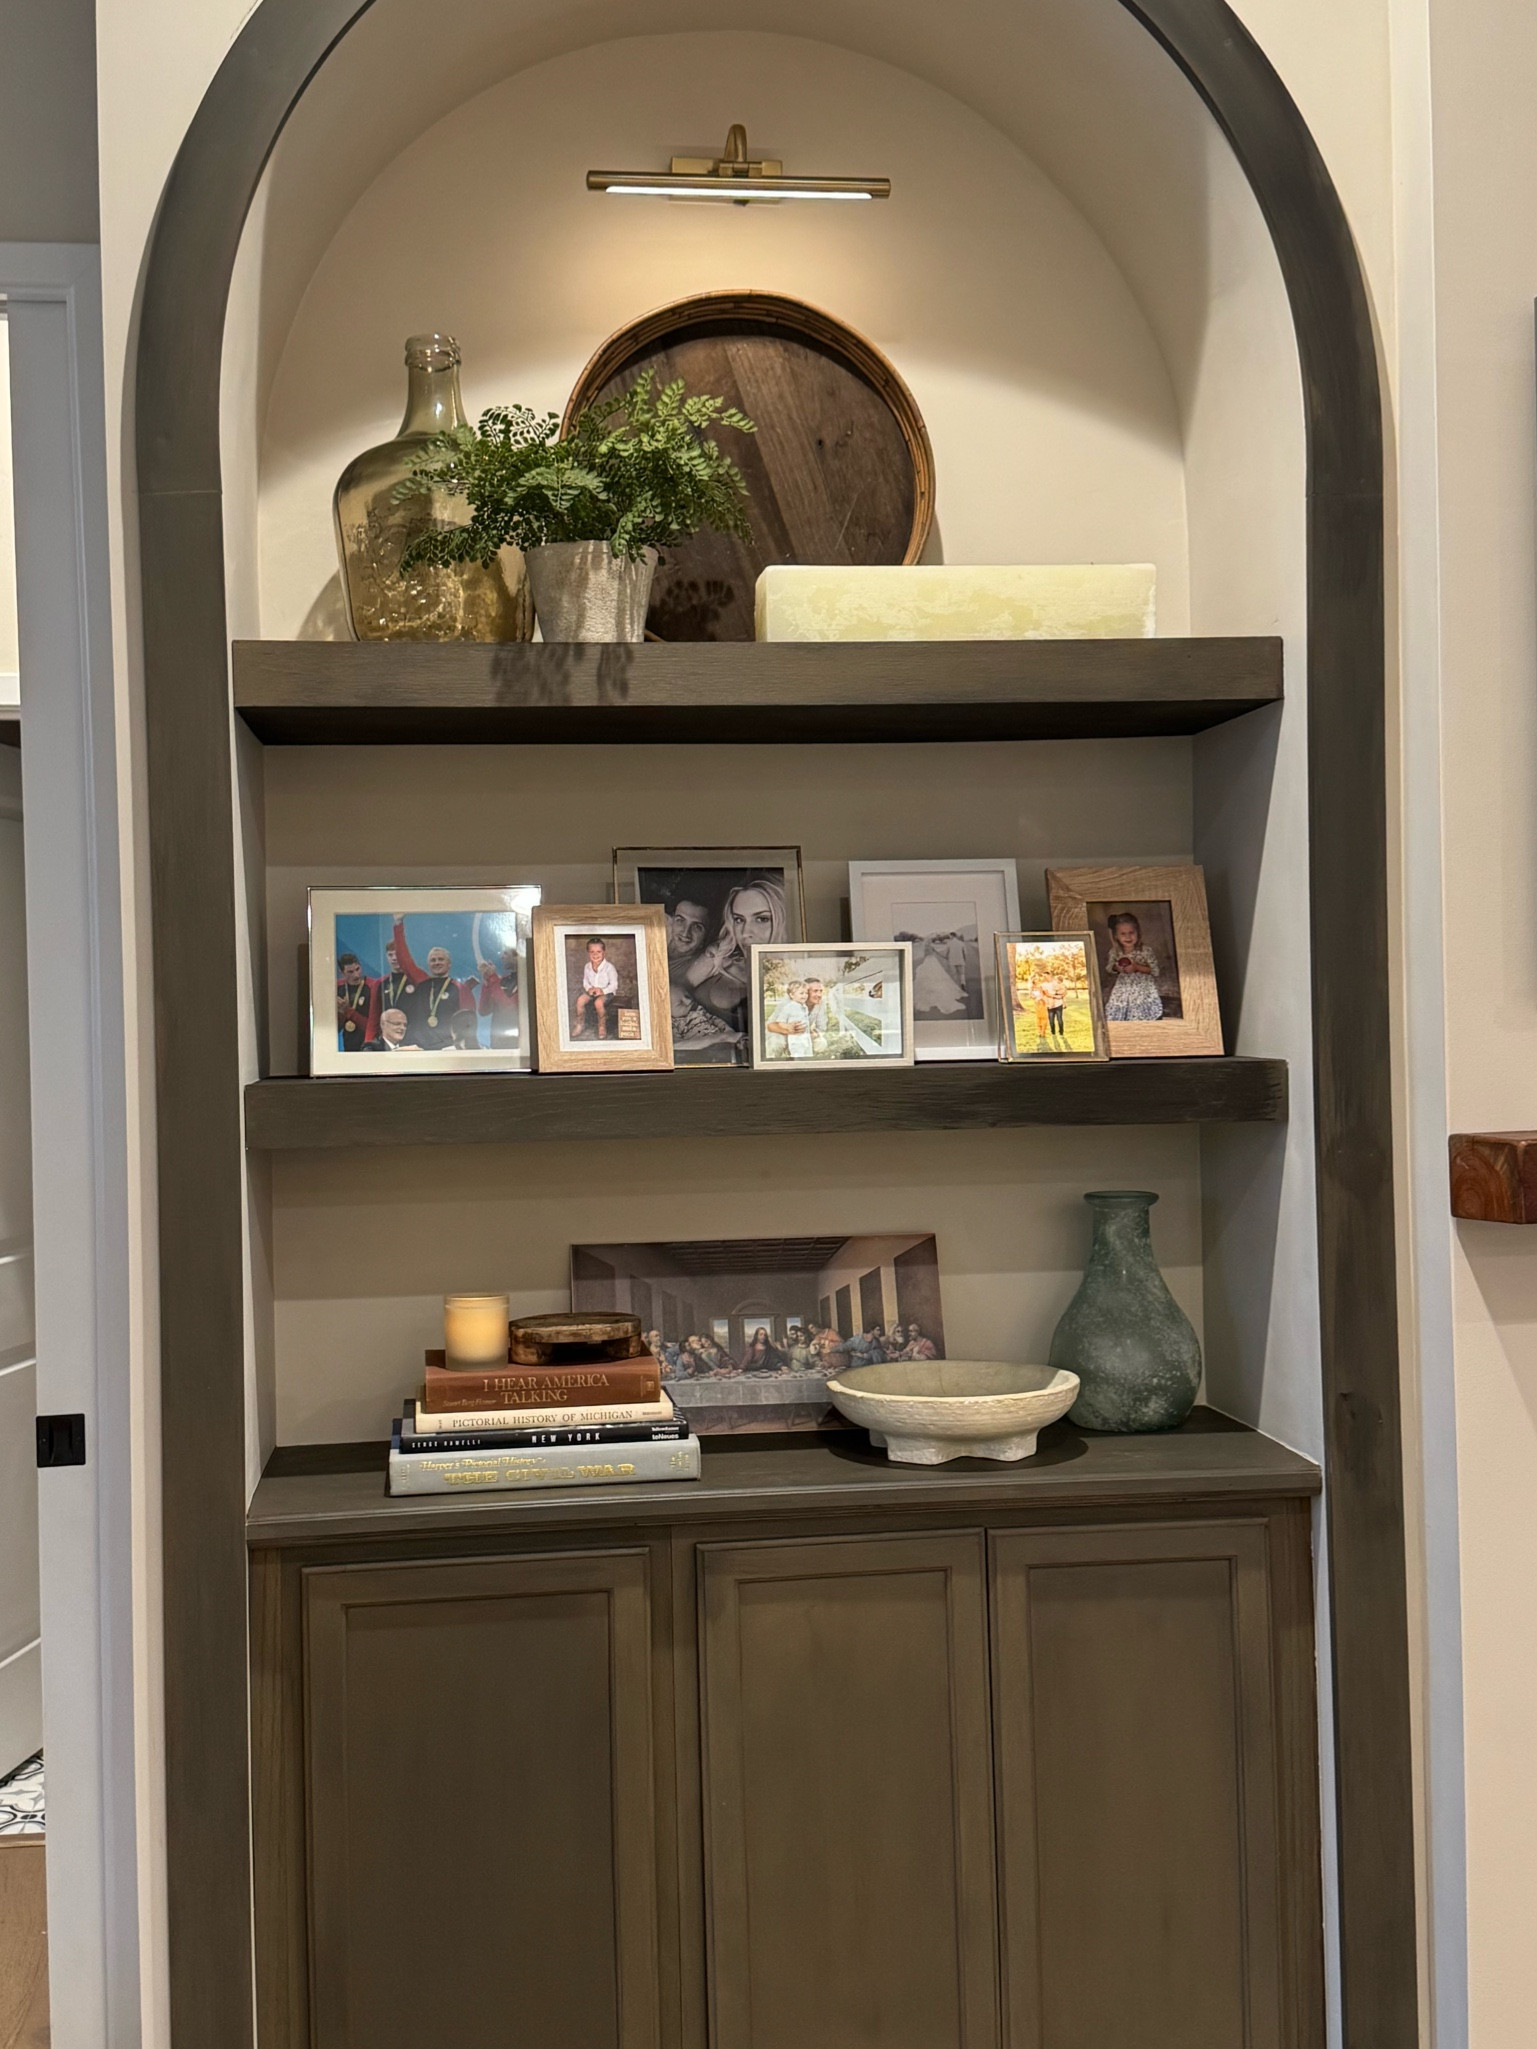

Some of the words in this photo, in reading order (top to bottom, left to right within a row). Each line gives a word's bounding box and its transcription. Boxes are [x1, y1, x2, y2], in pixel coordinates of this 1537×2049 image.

[483, 1379, 489, 1391] I
[494, 1377, 538, 1391] HEAR
[541, 1374, 610, 1388] AMERICA
[500, 1389, 568, 1404] TALKING
[452, 1416, 509, 1428] PICTORIAL
[513, 1413, 558, 1425] HISTORY
[562, 1412, 577, 1423] OF
[580, 1410, 633, 1421] MICHIGAN
[531, 1434, 557, 1444] NEW
[567, 1432, 601, 1442] YORK
[419, 1461, 460, 1472] Harper's
[462, 1458, 501, 1468] Pictorial
[443, 1471, 499, 1486] THE
[505, 1467, 576, 1482] CIVIL
[576, 1464, 636, 1478] WAR
